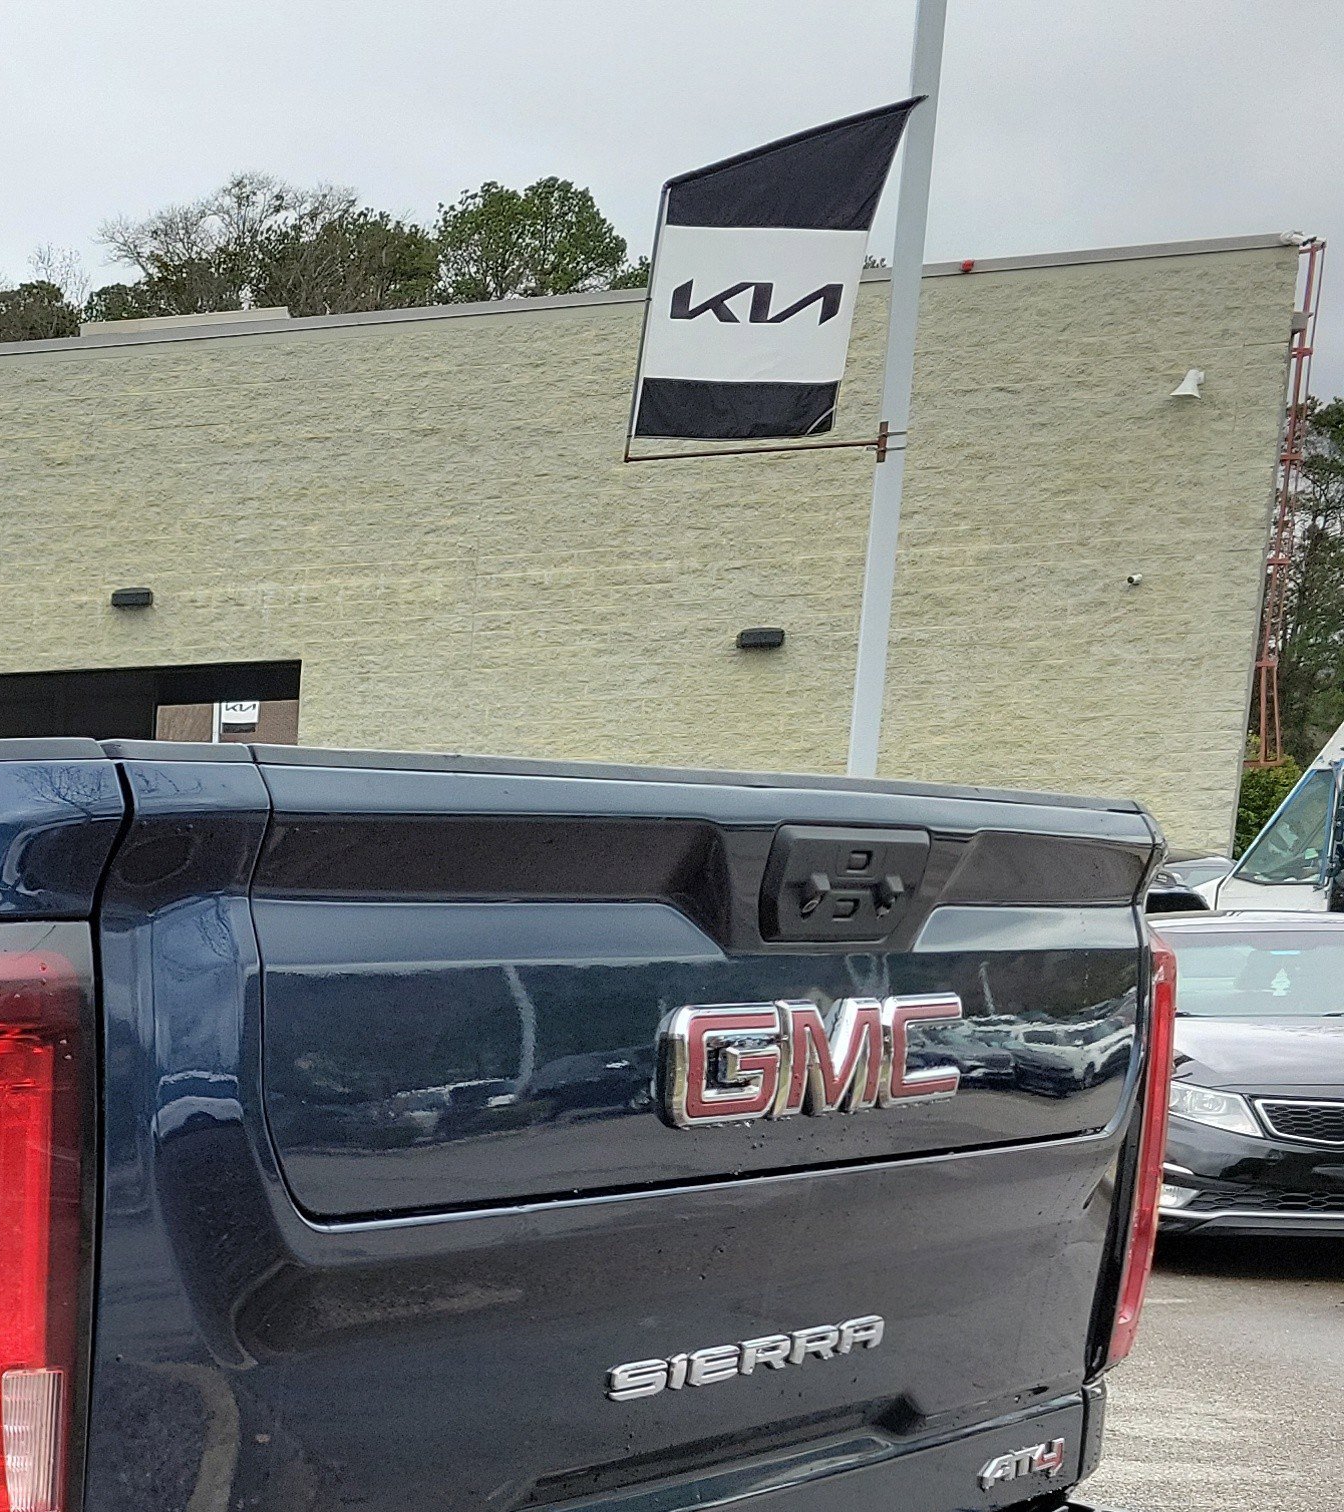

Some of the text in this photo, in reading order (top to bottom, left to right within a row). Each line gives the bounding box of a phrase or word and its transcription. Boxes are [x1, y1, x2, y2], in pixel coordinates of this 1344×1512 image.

[653, 991, 963, 1130] GMC
[605, 1314, 885, 1402] SIERRA
[977, 1437, 1065, 1491] AT4
